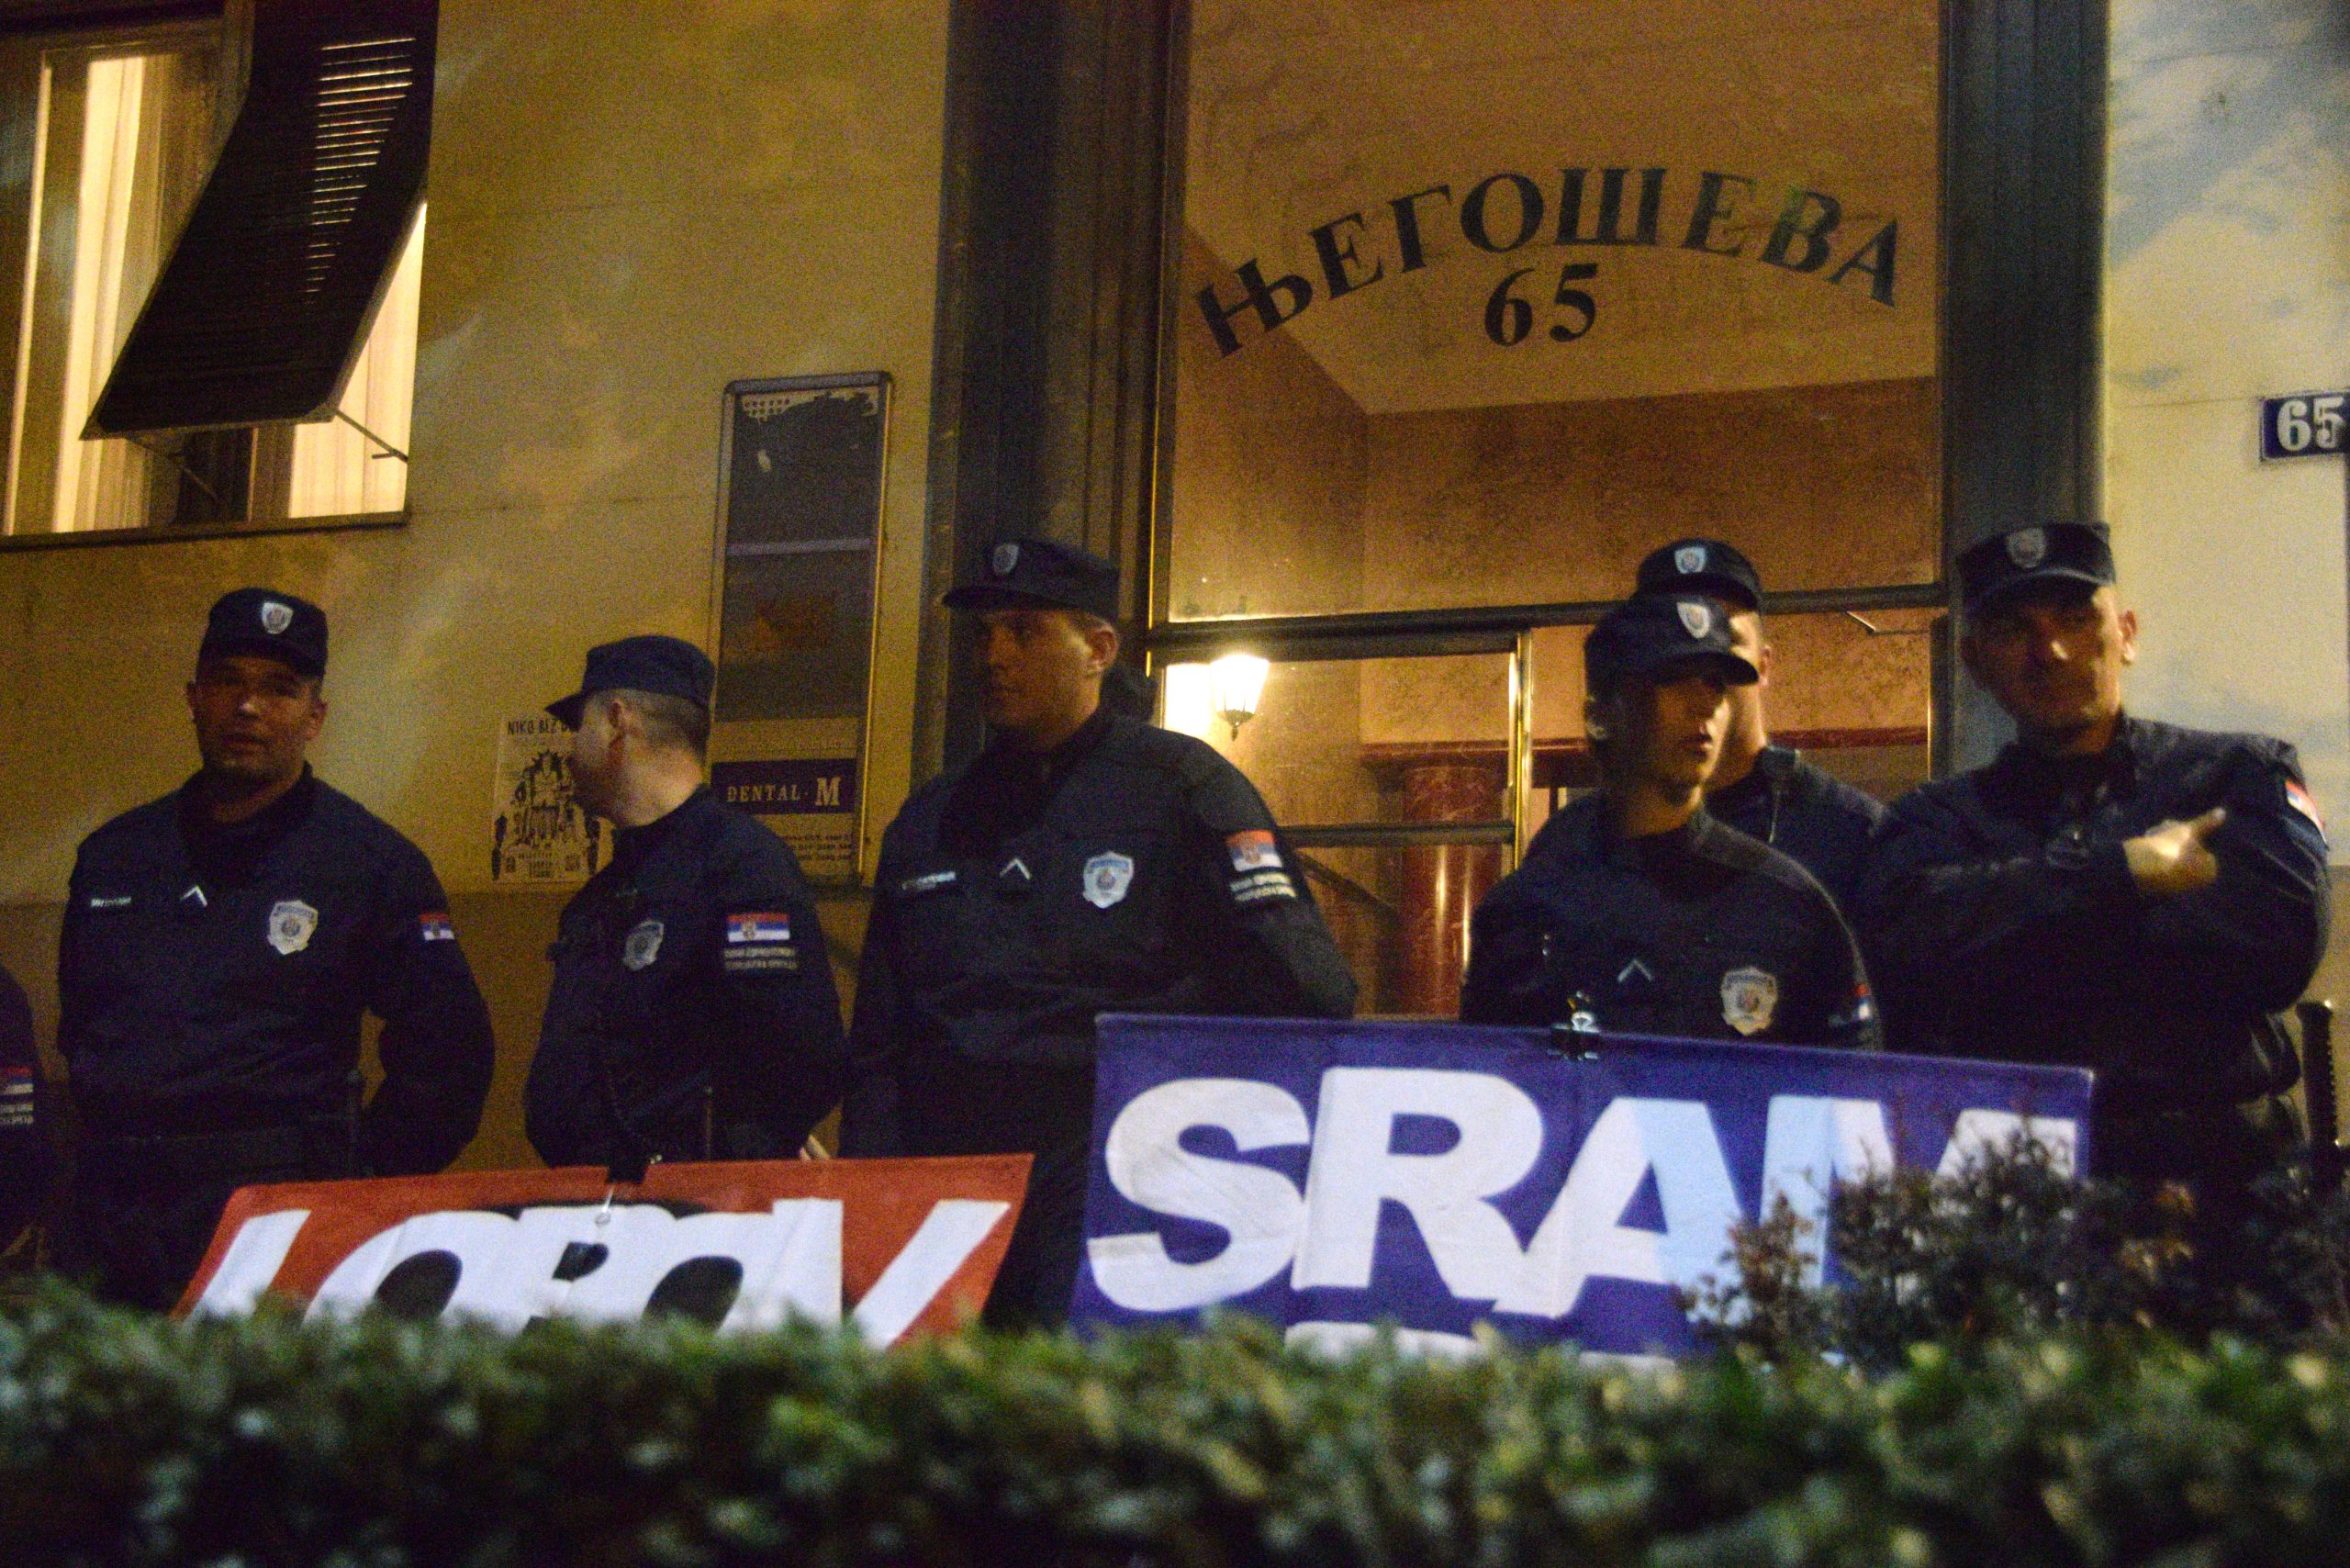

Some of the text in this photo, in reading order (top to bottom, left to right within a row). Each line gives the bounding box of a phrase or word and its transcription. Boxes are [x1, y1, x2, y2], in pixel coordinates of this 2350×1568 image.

[1193, 168, 1899, 359] ЊЕГОШЕВА
[1483, 263, 1598, 347] 65
[2276, 396, 2345, 453] 65
[726, 776, 842, 807] DENTAL M
